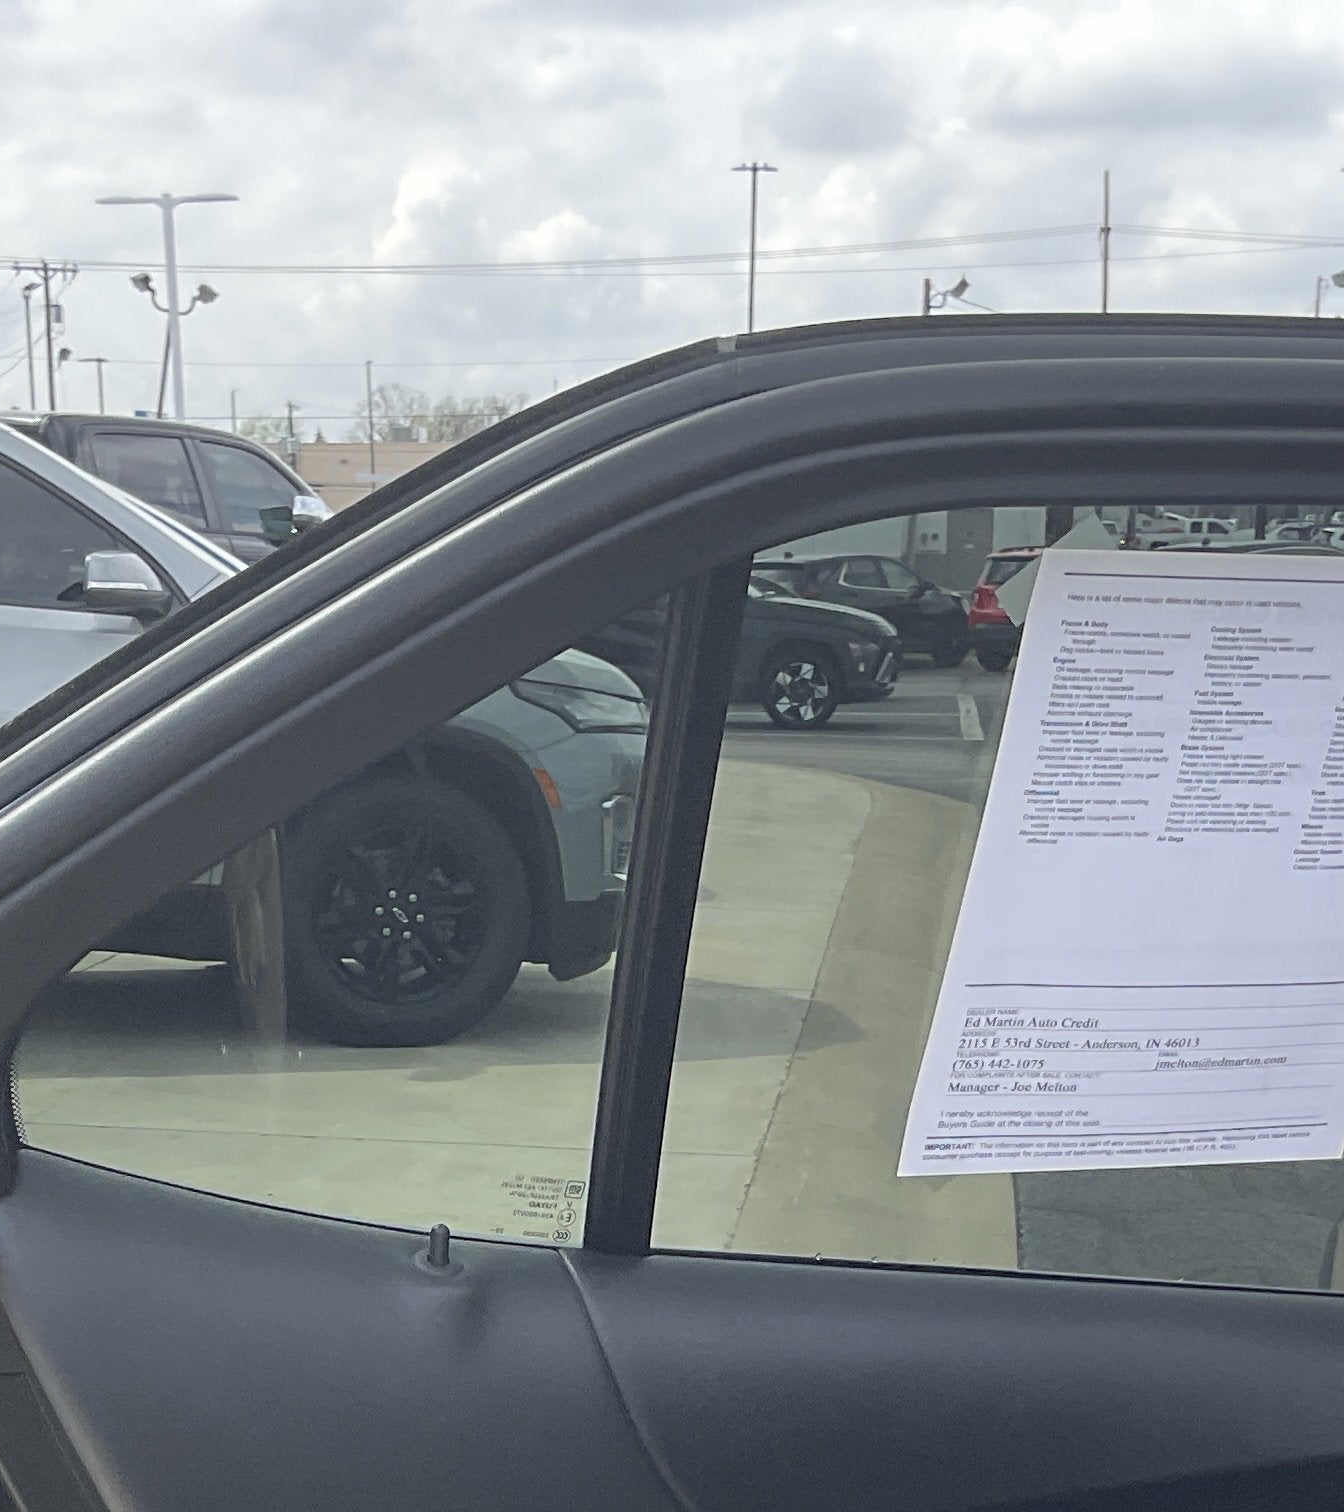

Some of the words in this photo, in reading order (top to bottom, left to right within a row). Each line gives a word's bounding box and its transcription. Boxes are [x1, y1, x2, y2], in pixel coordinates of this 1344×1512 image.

[964, 1018, 980, 1028] Ed
[983, 1017, 1024, 1028] Martin
[1027, 1018, 1058, 1028] Auto
[1061, 1018, 1099, 1028] Credit
[958, 1038, 987, 1049] 2115
[990, 1039, 1001, 1048] E
[1003, 1038, 1032, 1049] 53rd
[1034, 1038, 1070, 1049] Street
[1081, 1039, 1141, 1050] Anderson,
[1145, 1038, 1161, 1049] IN
[1164, 1038, 1200, 1048] 46013
[952, 1059, 985, 1072] (765)
[988, 1059, 1045, 1070] 442-1075
[947, 1082, 1000, 1095] Manager
[1010, 1082, 1032, 1093] Joe
[1035, 1082, 1078, 1092] Melton
[976, 1110, 1033, 1118] acknowledge
[1064, 1109, 1074, 1117] of
[937, 1120, 968, 1129] Buyers
[969, 1120, 995, 1128] Guide
[1007, 1120, 1021, 1128] the
